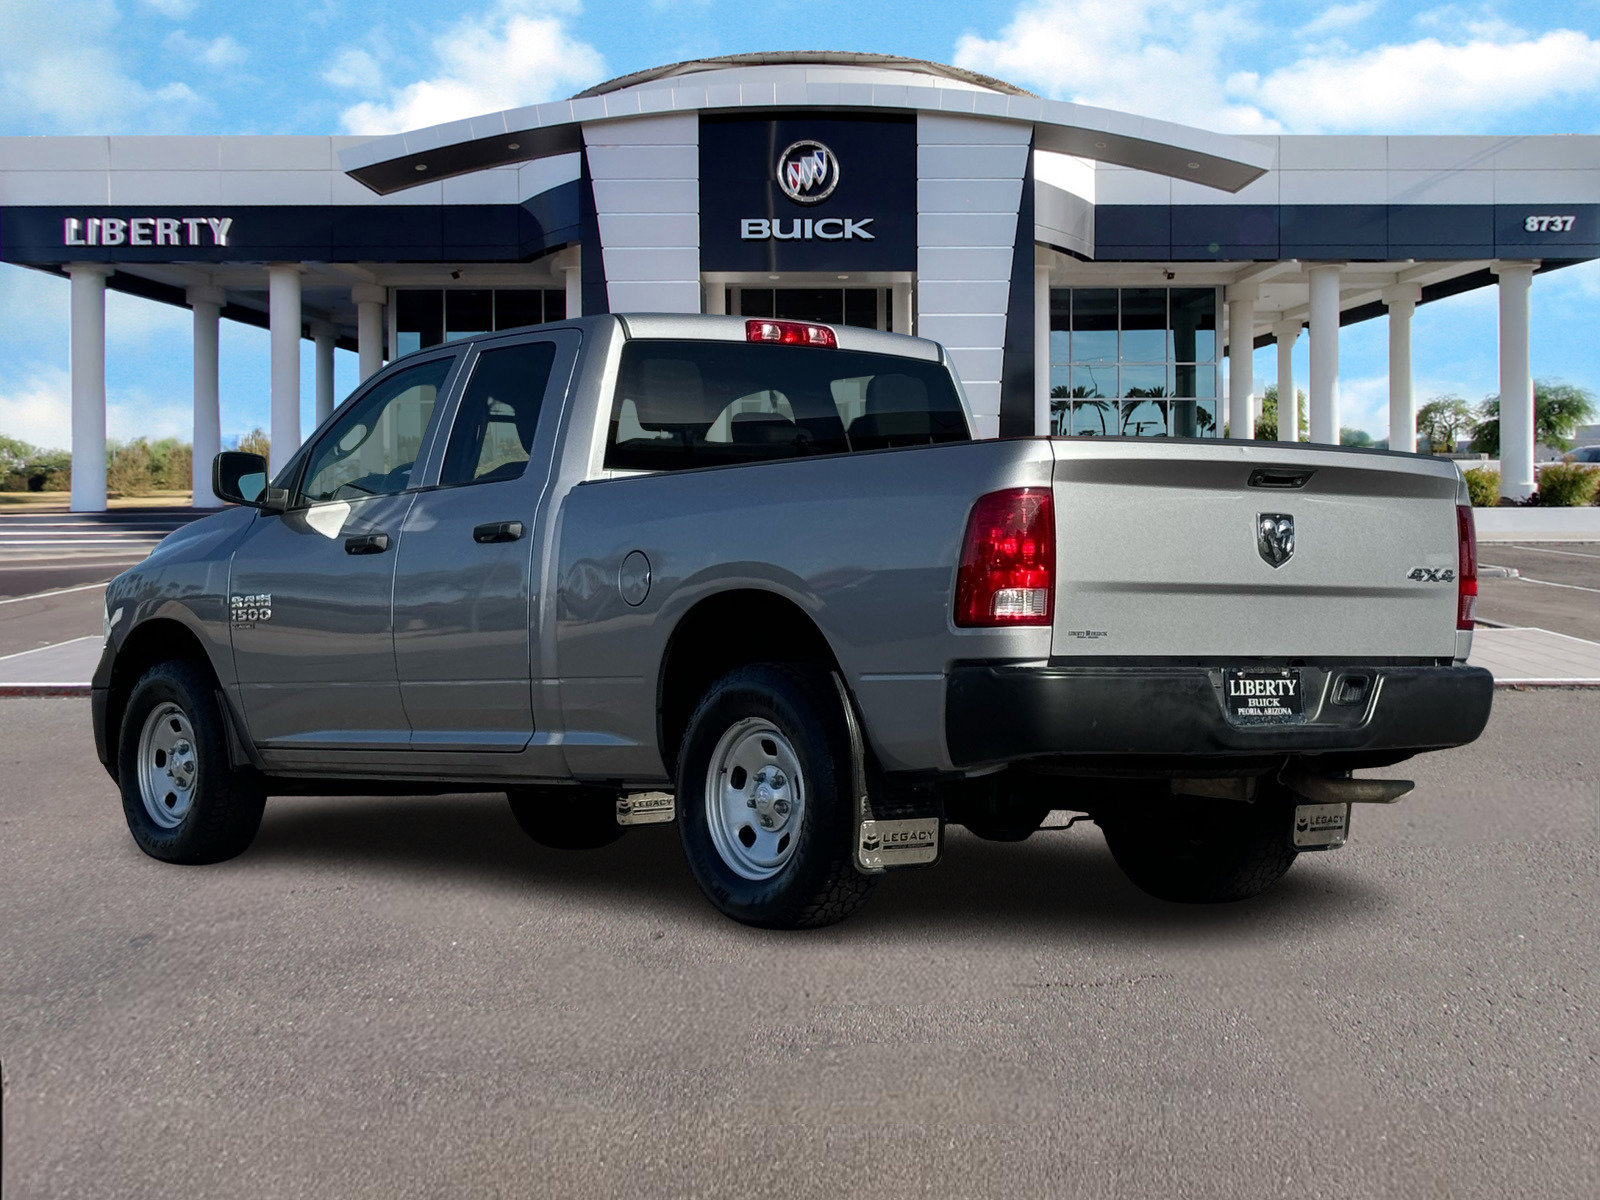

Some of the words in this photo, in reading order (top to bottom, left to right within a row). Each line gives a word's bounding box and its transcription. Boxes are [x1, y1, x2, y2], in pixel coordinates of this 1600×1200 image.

[740, 218, 876, 239] BUICK
[1524, 215, 1576, 232] 8737
[64, 217, 233, 246] LIBERTY
[231, 594, 271, 608] RAM
[231, 608, 271, 621] 1500
[1229, 679, 1297, 696] LIBERTY
[1247, 698, 1281, 707] BUICK
[1263, 707, 1293, 716] ARIZONA
[633, 799, 672, 808] LEGACY
[1309, 815, 1344, 825] LEGACY
[882, 830, 935, 843] LEGACY
